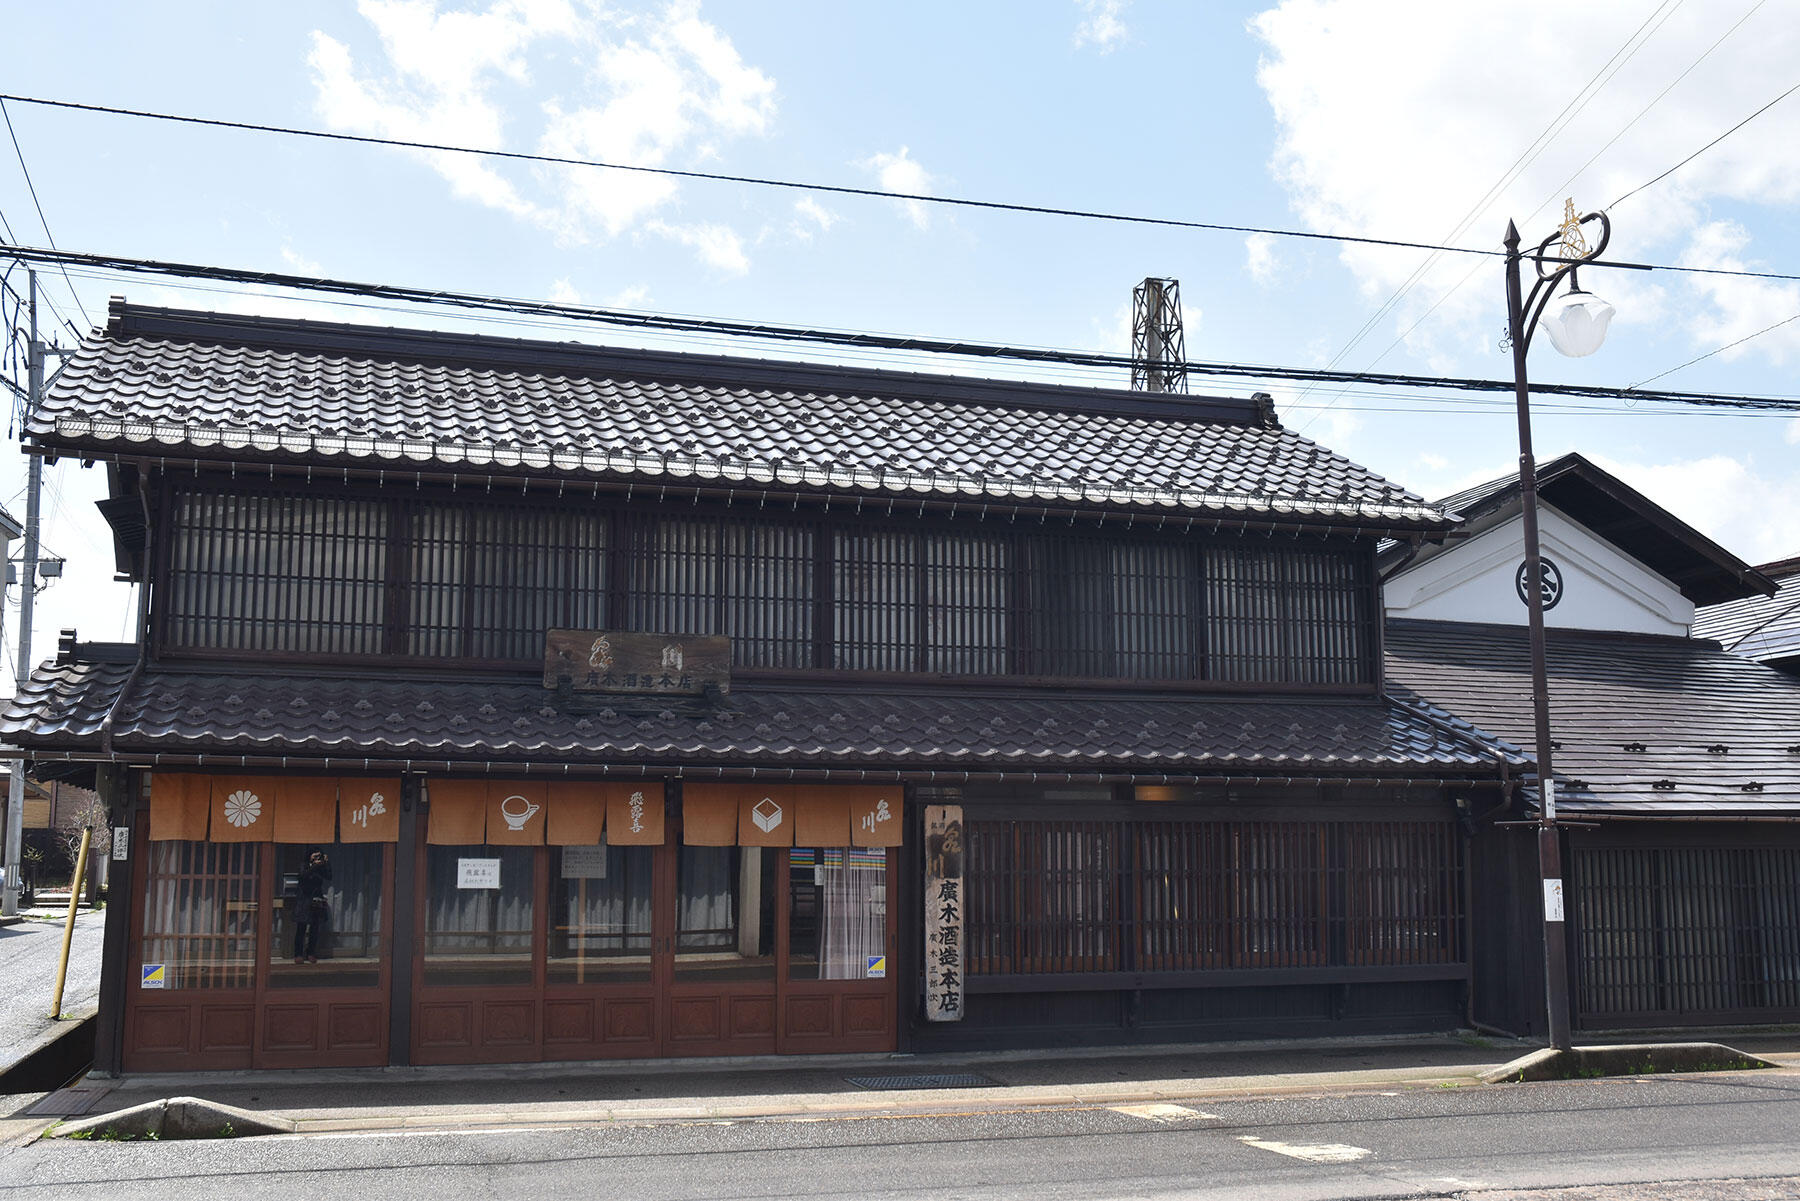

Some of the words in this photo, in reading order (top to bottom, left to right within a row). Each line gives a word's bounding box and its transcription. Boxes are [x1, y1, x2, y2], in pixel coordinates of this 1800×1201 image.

[937, 879, 961, 1012] 廣木酒造本店
